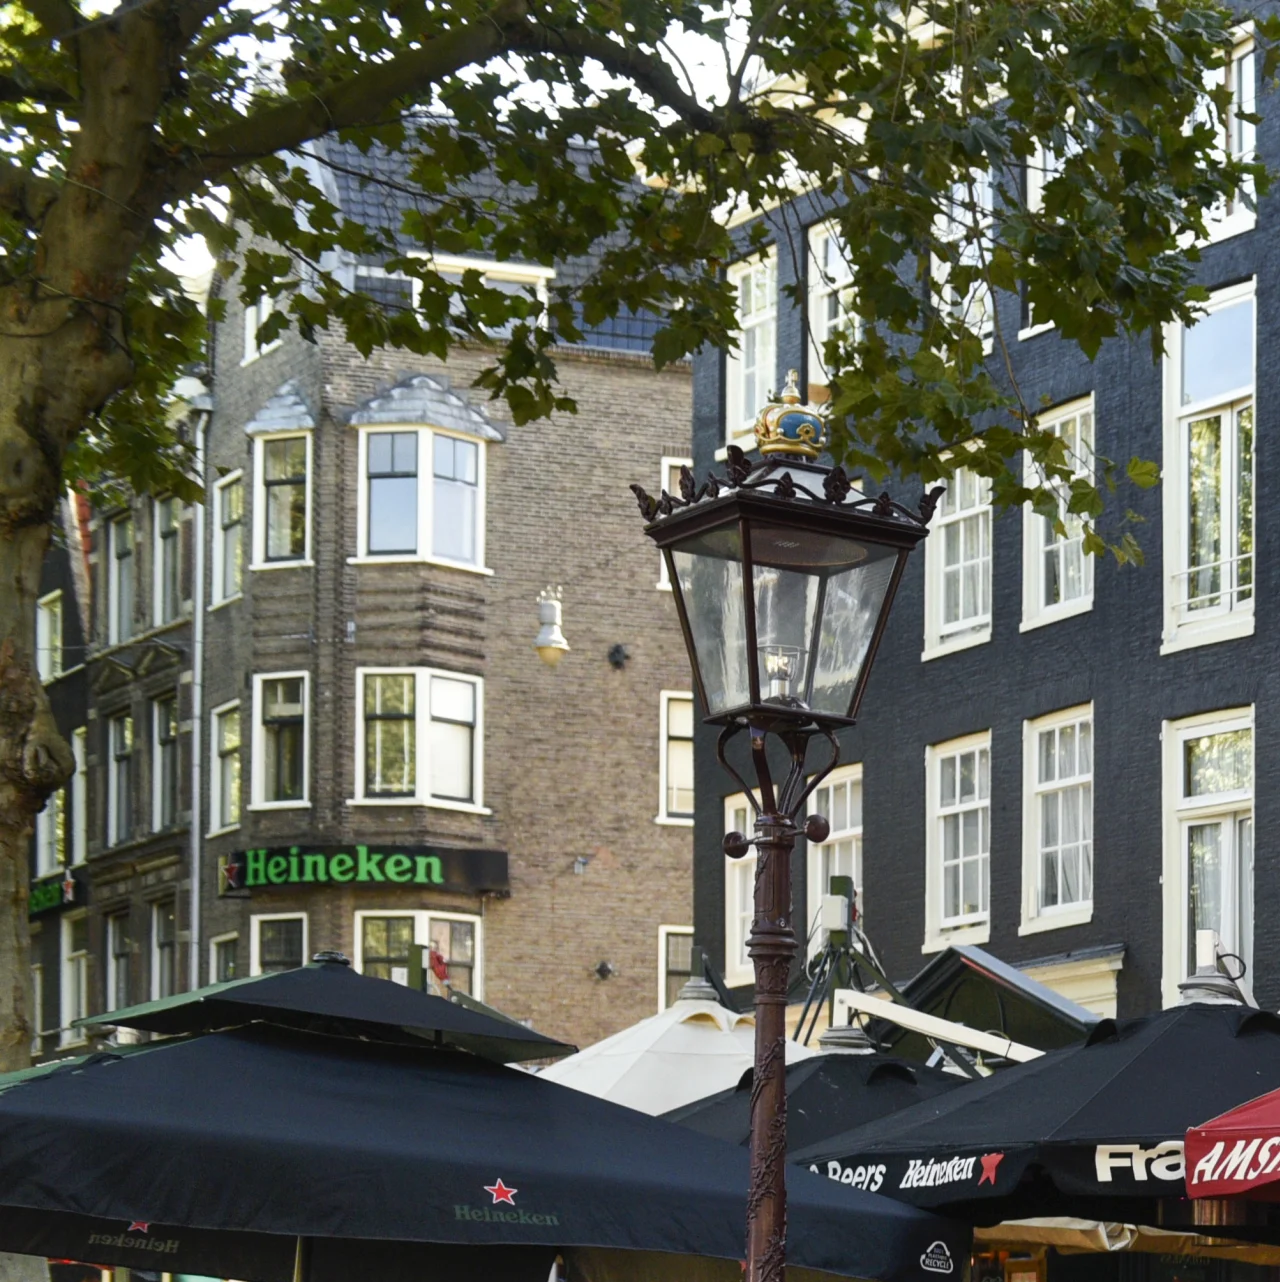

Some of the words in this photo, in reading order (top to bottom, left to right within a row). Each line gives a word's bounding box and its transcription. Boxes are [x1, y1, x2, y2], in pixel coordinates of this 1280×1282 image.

[245, 846, 444, 887] Heineken
[899, 1156, 976, 1190] Heineken
[453, 1204, 560, 1227] Heineken
